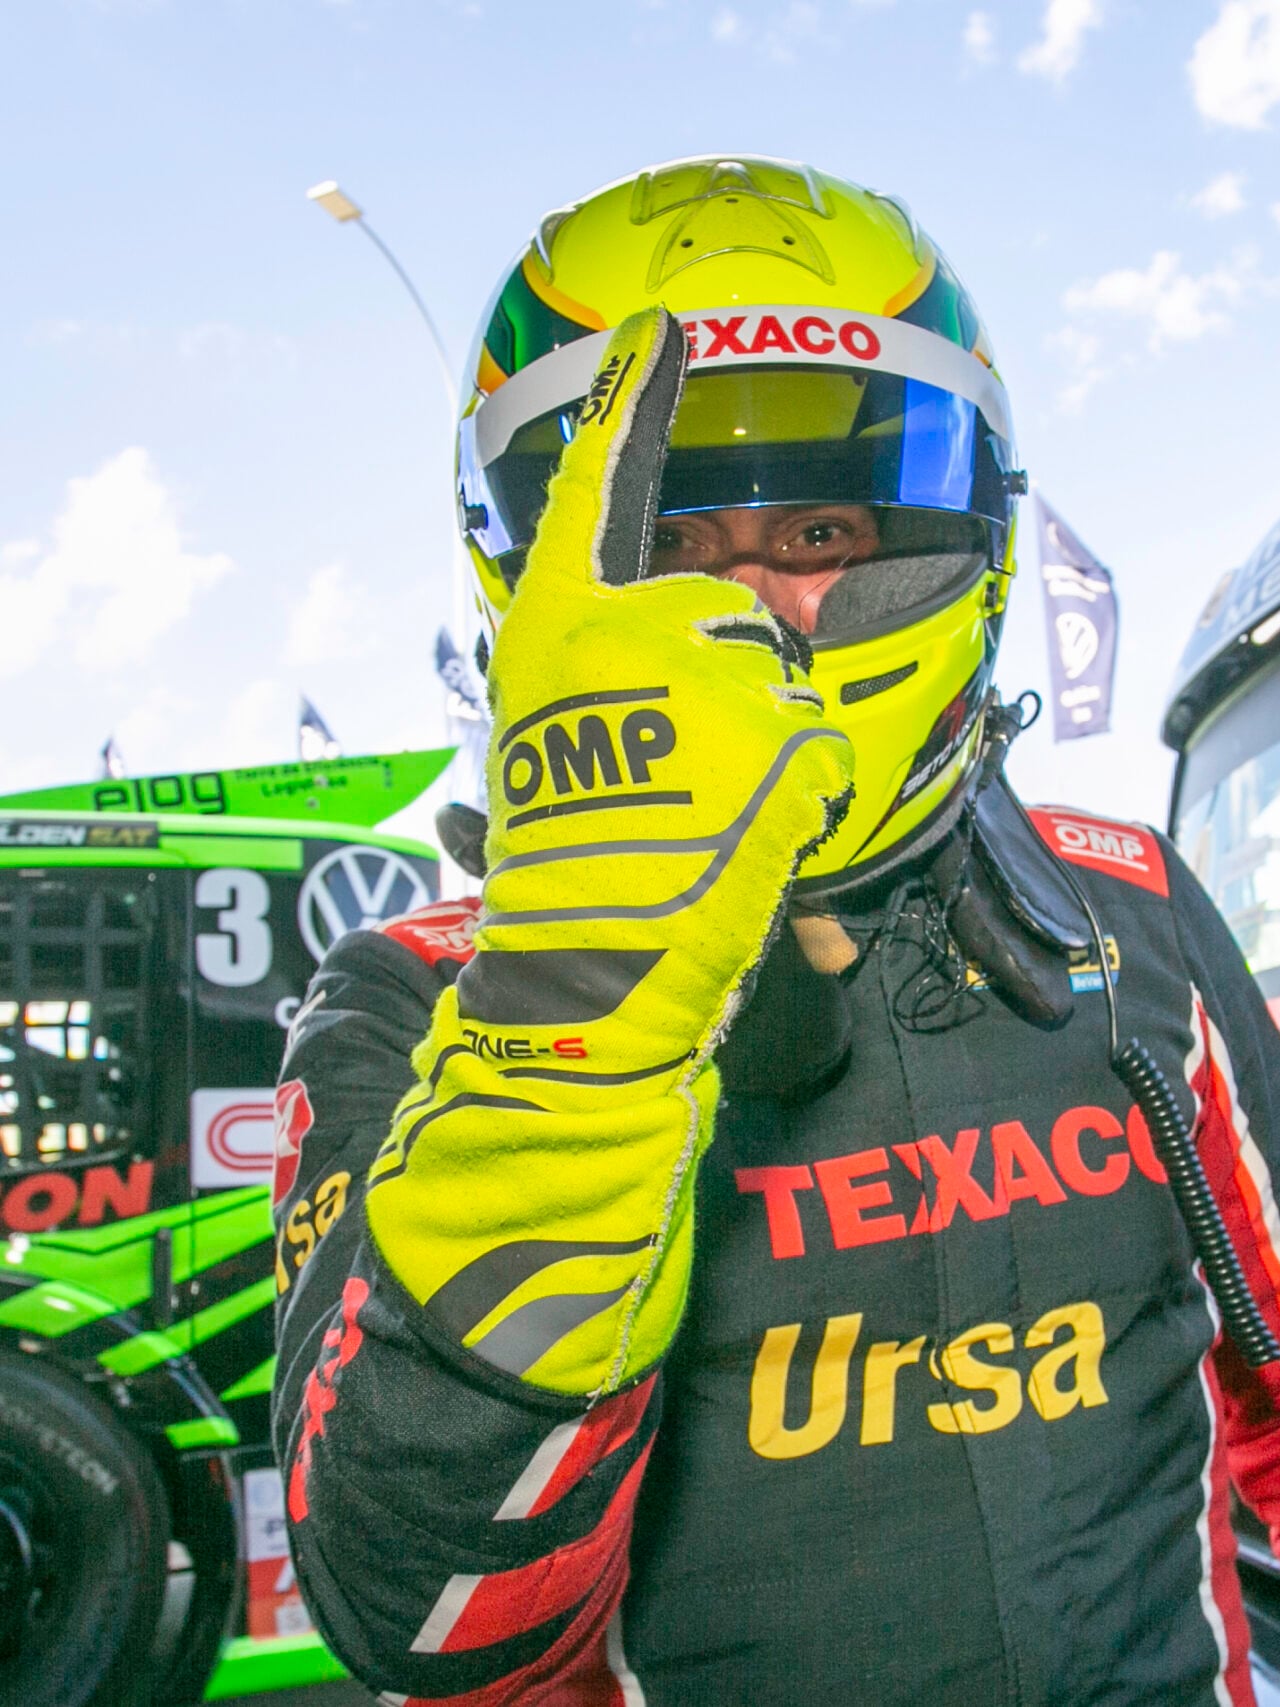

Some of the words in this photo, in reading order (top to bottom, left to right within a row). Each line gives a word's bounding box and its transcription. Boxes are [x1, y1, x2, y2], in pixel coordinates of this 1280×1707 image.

[682, 315, 881, 361] EXACO
[503, 709, 676, 806] OMP
[1056, 826, 1144, 861] OMP
[195, 868, 272, 987] 3
[748, 1301, 1108, 1459] Ursa
